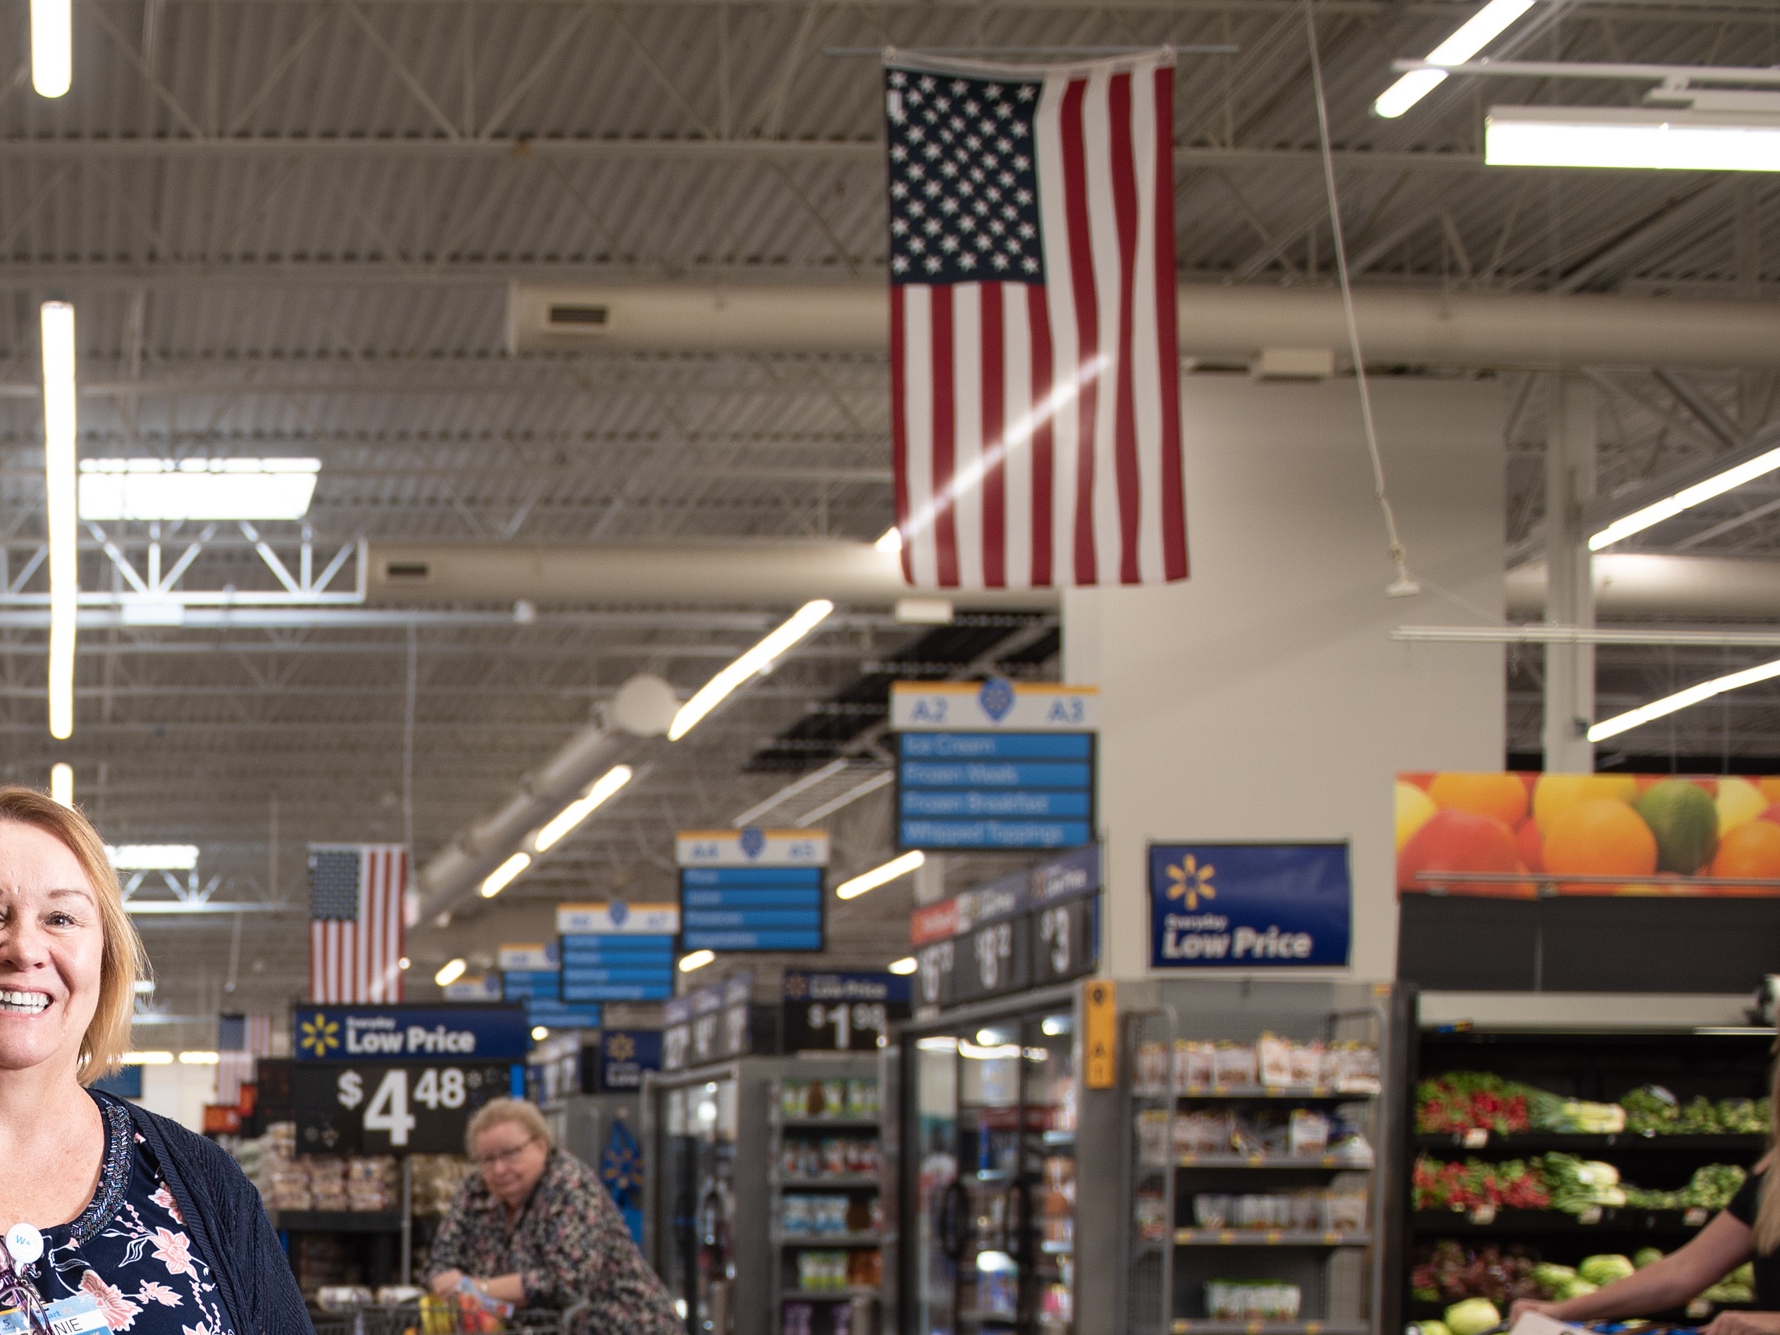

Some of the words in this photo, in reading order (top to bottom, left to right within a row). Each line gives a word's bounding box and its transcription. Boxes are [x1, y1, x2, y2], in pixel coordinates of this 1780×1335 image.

[909, 697, 949, 723] A2
[1048, 696, 1085, 723] A3
[934, 735, 996, 755] Cream
[906, 763, 961, 781] Frozen
[906, 792, 960, 811] Frozen
[966, 792, 1049, 814] Breakfast
[1164, 913, 1228, 932] Everyday
[1161, 928, 1230, 960] Low
[1231, 924, 1313, 960] Price
[345, 1015, 395, 1031] Everyday
[345, 1028, 404, 1054] Low
[407, 1024, 476, 1054] Price
